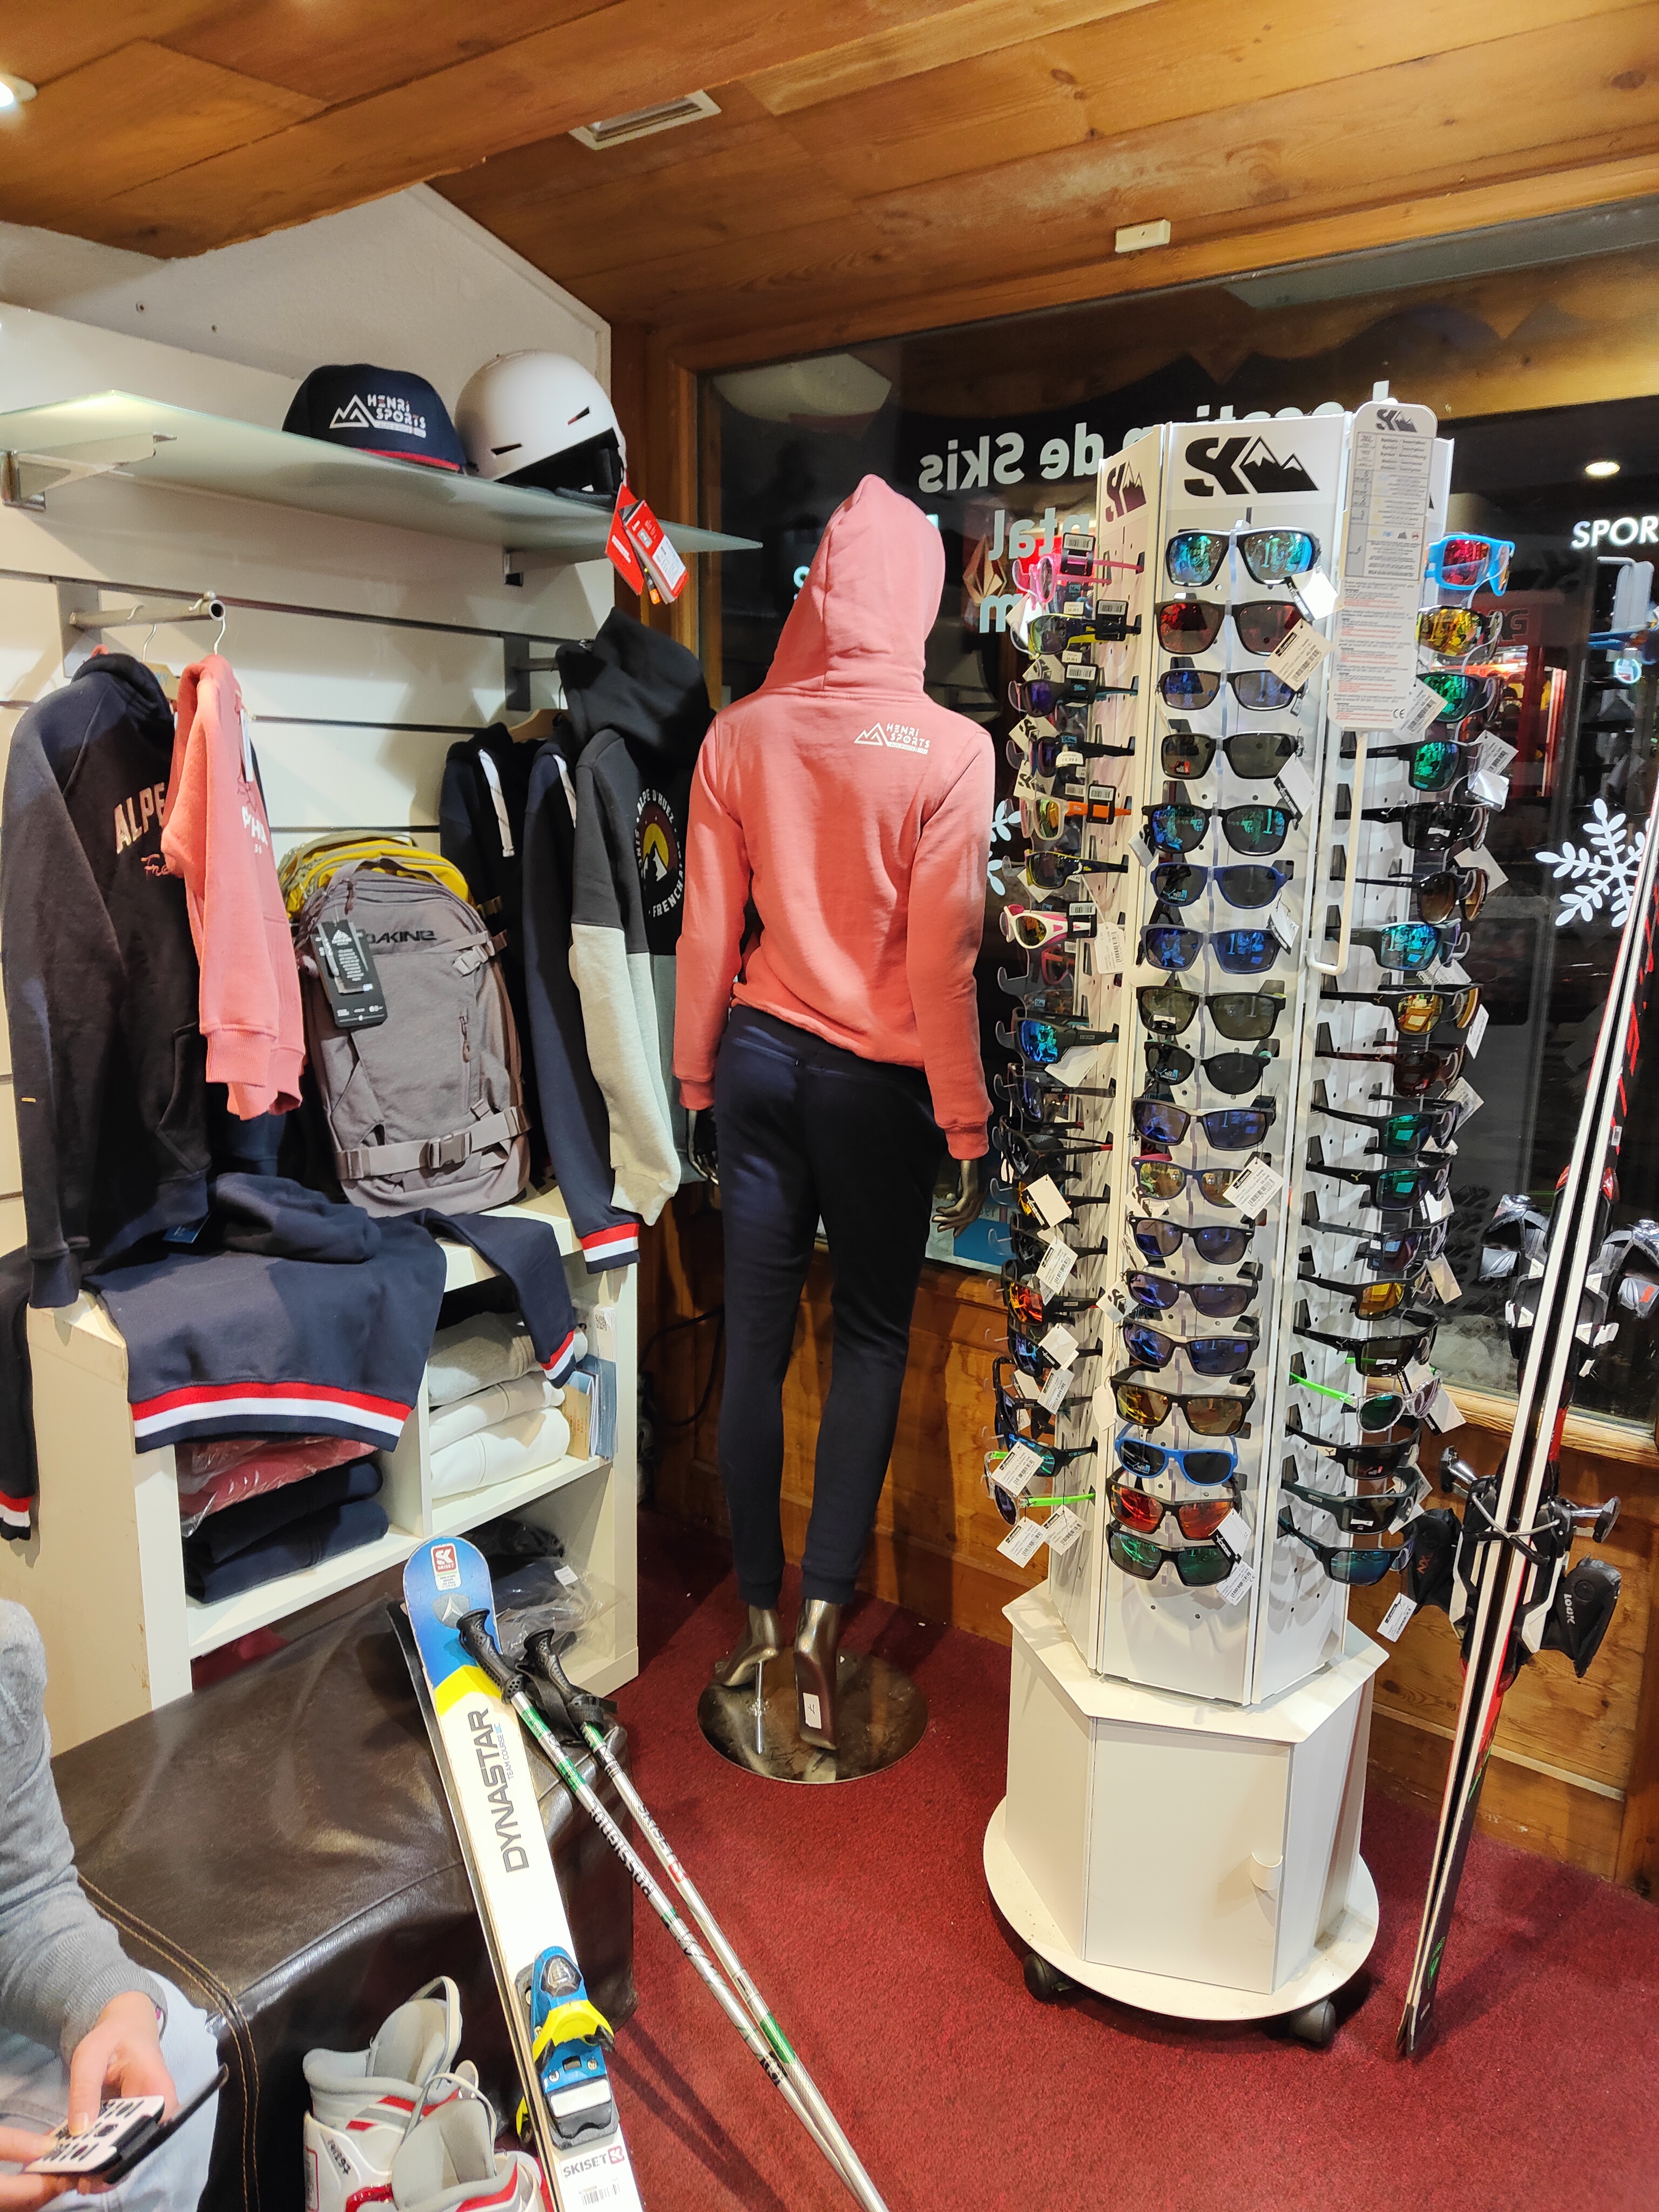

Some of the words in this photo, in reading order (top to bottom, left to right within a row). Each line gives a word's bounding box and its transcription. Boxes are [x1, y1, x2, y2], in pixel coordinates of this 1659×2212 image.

[367, 394, 410, 413] HENRI
[376, 407, 426, 429] SPORTS
[886, 723, 919, 737] HENRI
[890, 732, 930, 748] SPORTS
[637, 788, 650, 816] ALPE
[652, 789, 674, 824] D'HUEZ
[653, 879, 683, 918] FRENCH
[468, 1708, 529, 1873] DYNASTAR
[563, 2154, 608, 2179] SKISET
